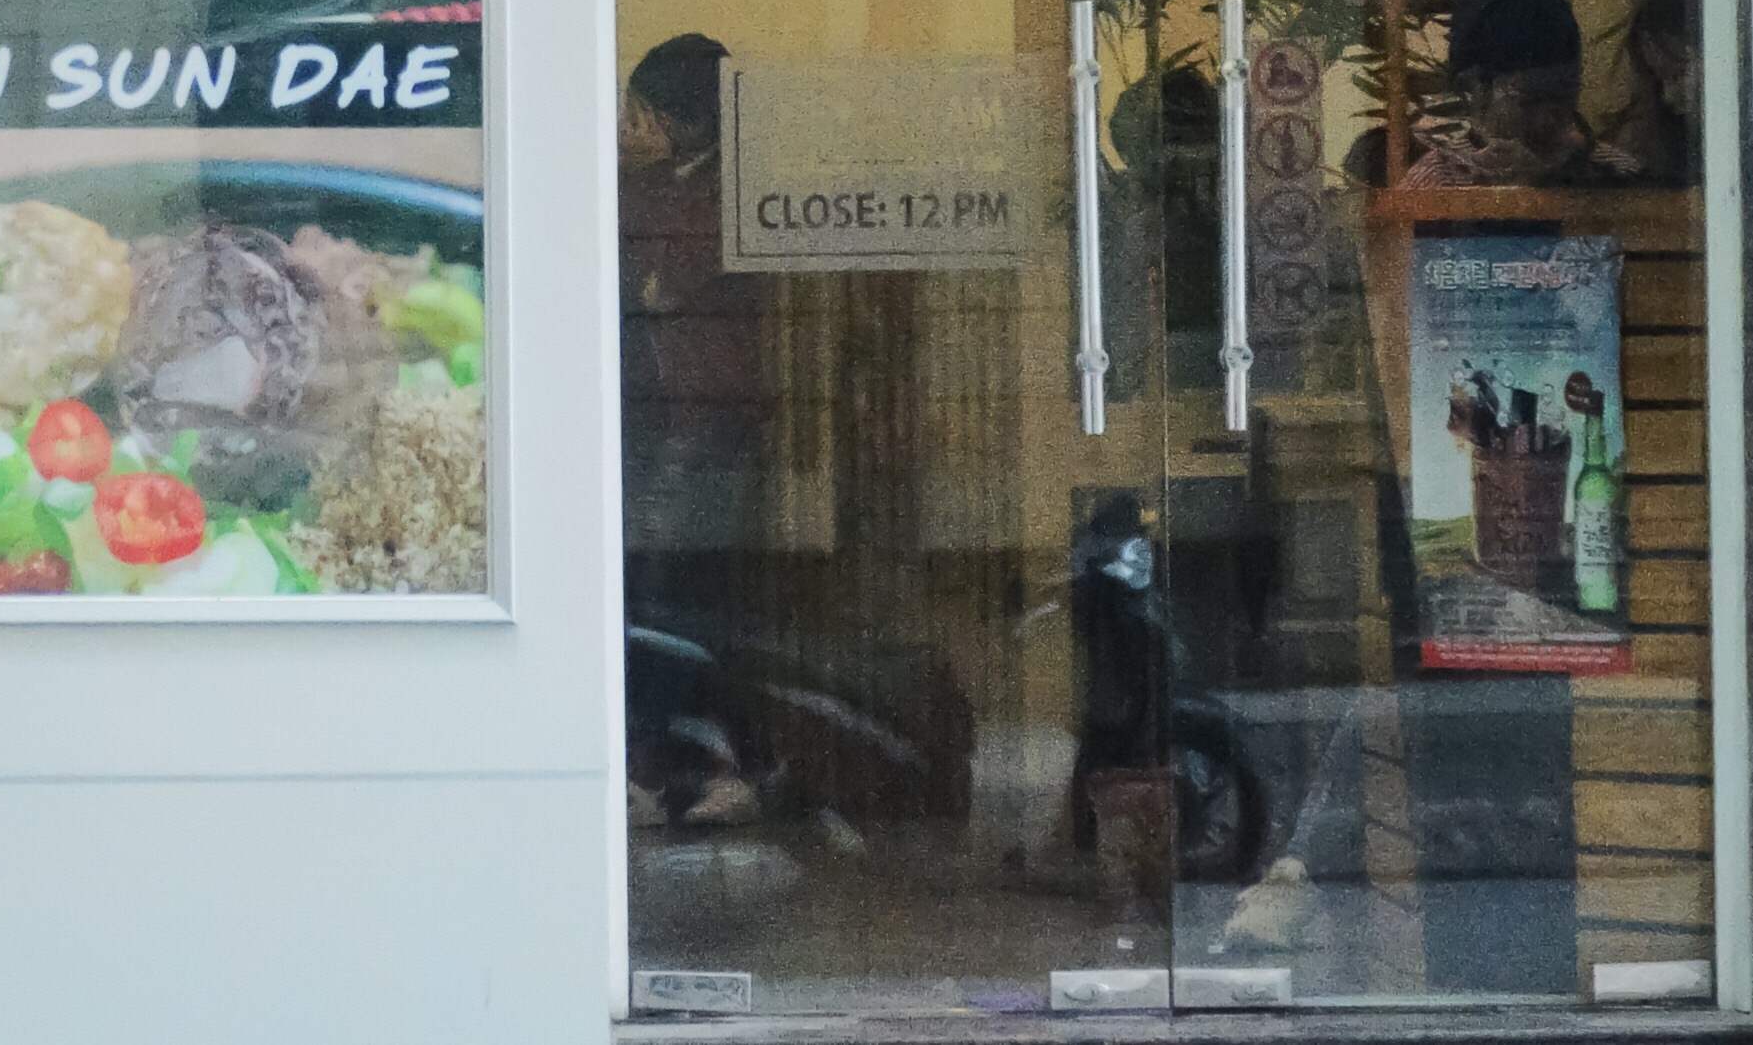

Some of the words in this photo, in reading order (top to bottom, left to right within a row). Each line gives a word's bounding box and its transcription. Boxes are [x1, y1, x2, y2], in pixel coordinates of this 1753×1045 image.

[47, 42, 239, 111] SUN
[269, 41, 461, 111] DAE
[756, 189, 888, 230] CLOSE:
[899, 192, 945, 229] 12
[952, 190, 1011, 229] PM
